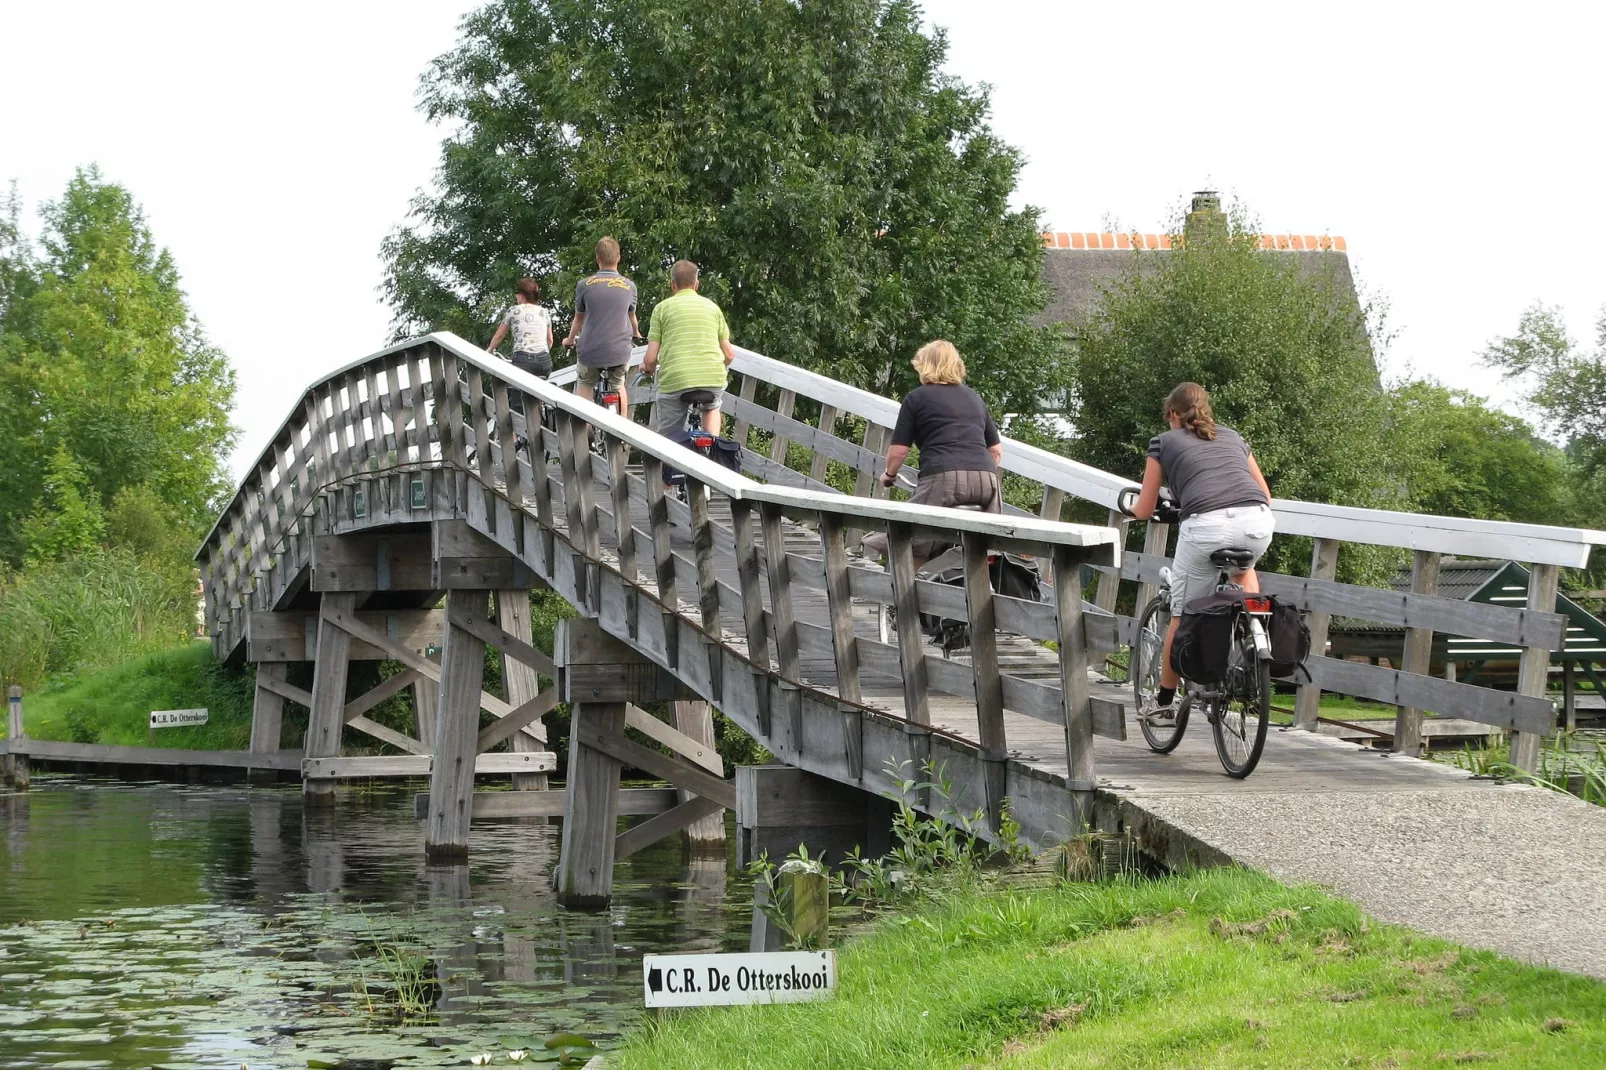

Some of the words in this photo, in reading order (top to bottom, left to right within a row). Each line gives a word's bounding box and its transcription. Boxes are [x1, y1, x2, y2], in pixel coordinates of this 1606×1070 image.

[170, 714, 178, 722] De
[666, 968, 702, 993] C.R.
[708, 967, 731, 992] De
[737, 964, 828, 991] Otterskooi
